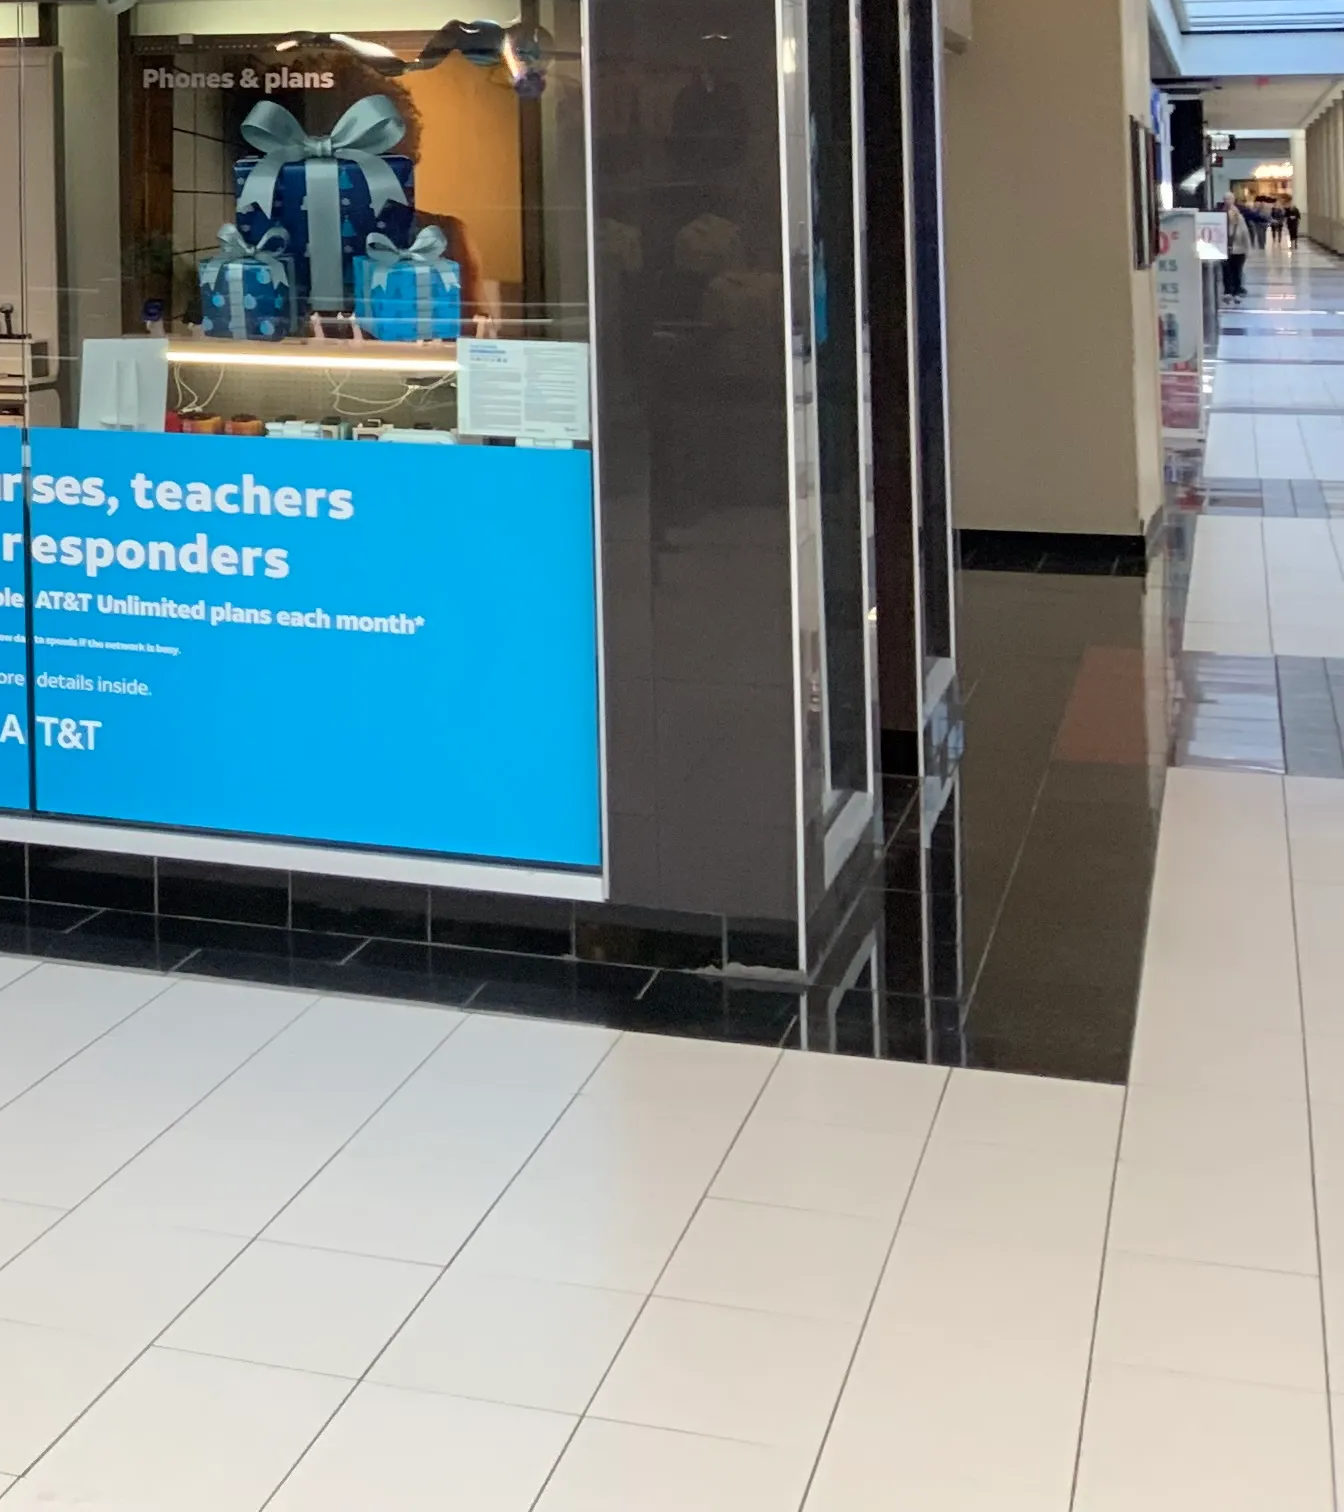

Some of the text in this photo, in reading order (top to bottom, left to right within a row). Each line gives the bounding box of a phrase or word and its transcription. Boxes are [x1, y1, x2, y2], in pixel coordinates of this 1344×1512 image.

[143, 67, 335, 94] Phones & plans
[130, 472, 355, 520] teachers
[2, 531, 290, 579] responders
[34, 590, 93, 613] AT&T
[97, 594, 206, 621] Unlimited
[210, 602, 272, 626] plans
[276, 607, 331, 630] each
[36, 672, 94, 692] details
[97, 676, 153, 696] inside.
[0, 713, 103, 750] AT&T
